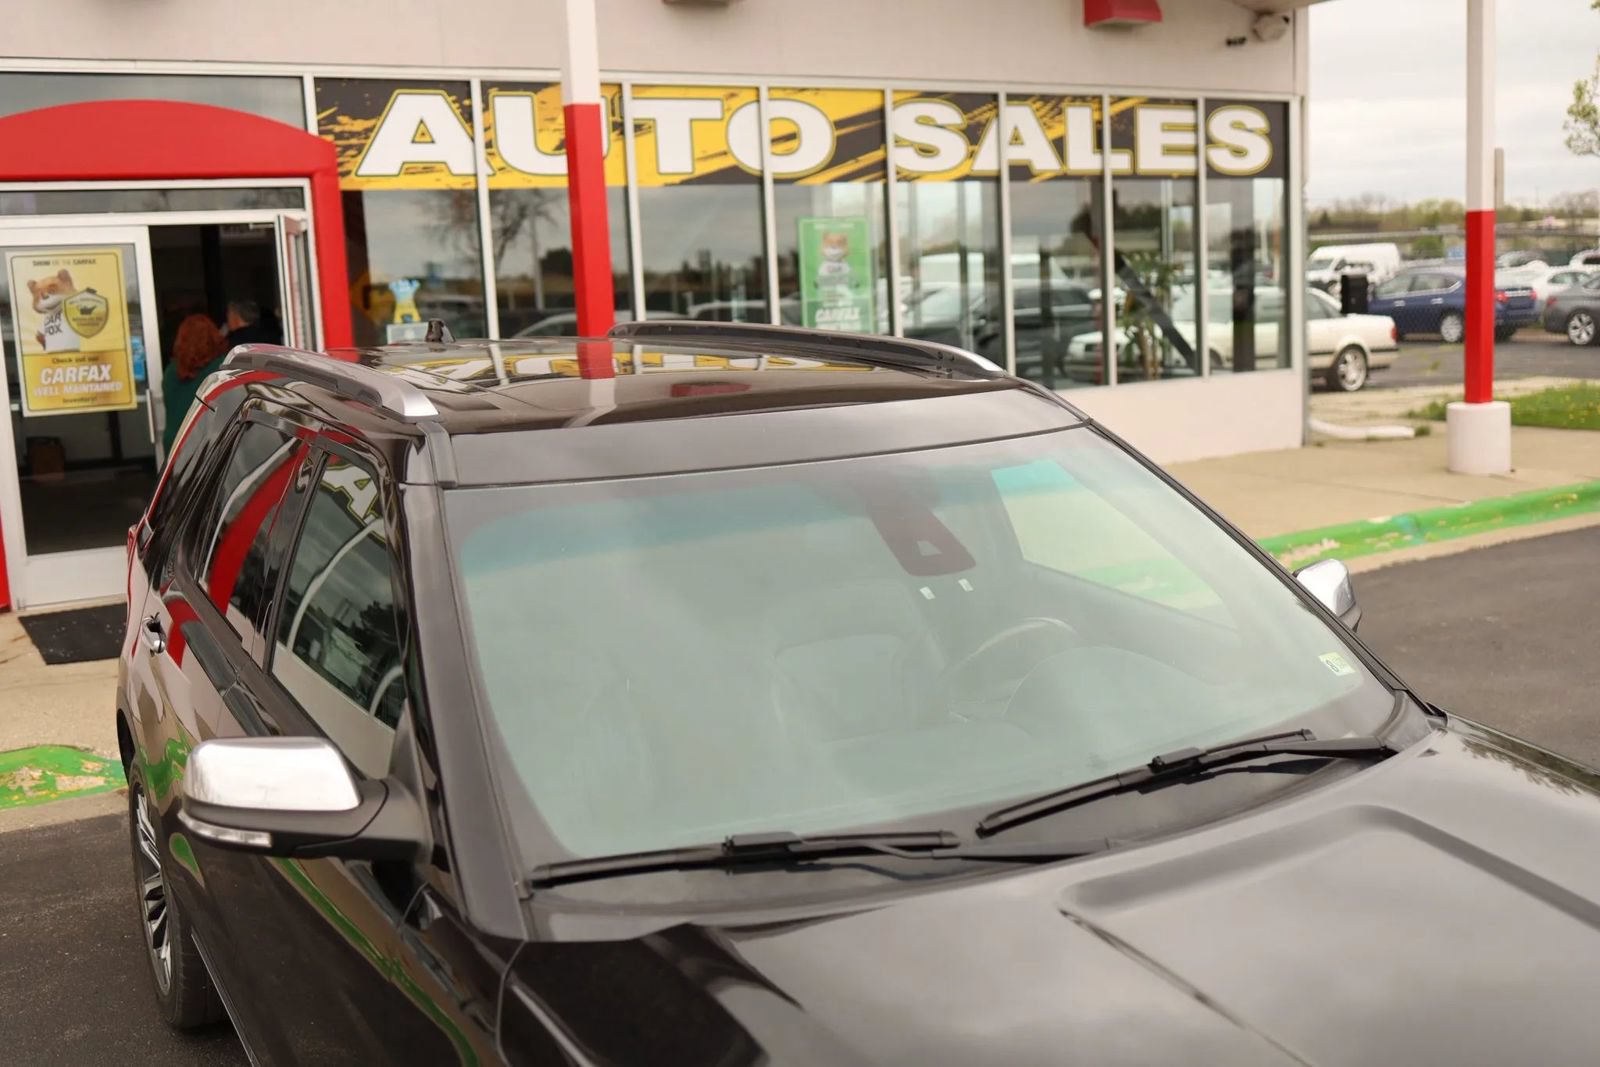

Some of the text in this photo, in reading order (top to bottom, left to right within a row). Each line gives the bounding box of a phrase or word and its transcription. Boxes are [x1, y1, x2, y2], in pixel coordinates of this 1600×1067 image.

[354, 88, 1273, 179] AUTO SALES
[41, 364, 112, 385] CARFAX
